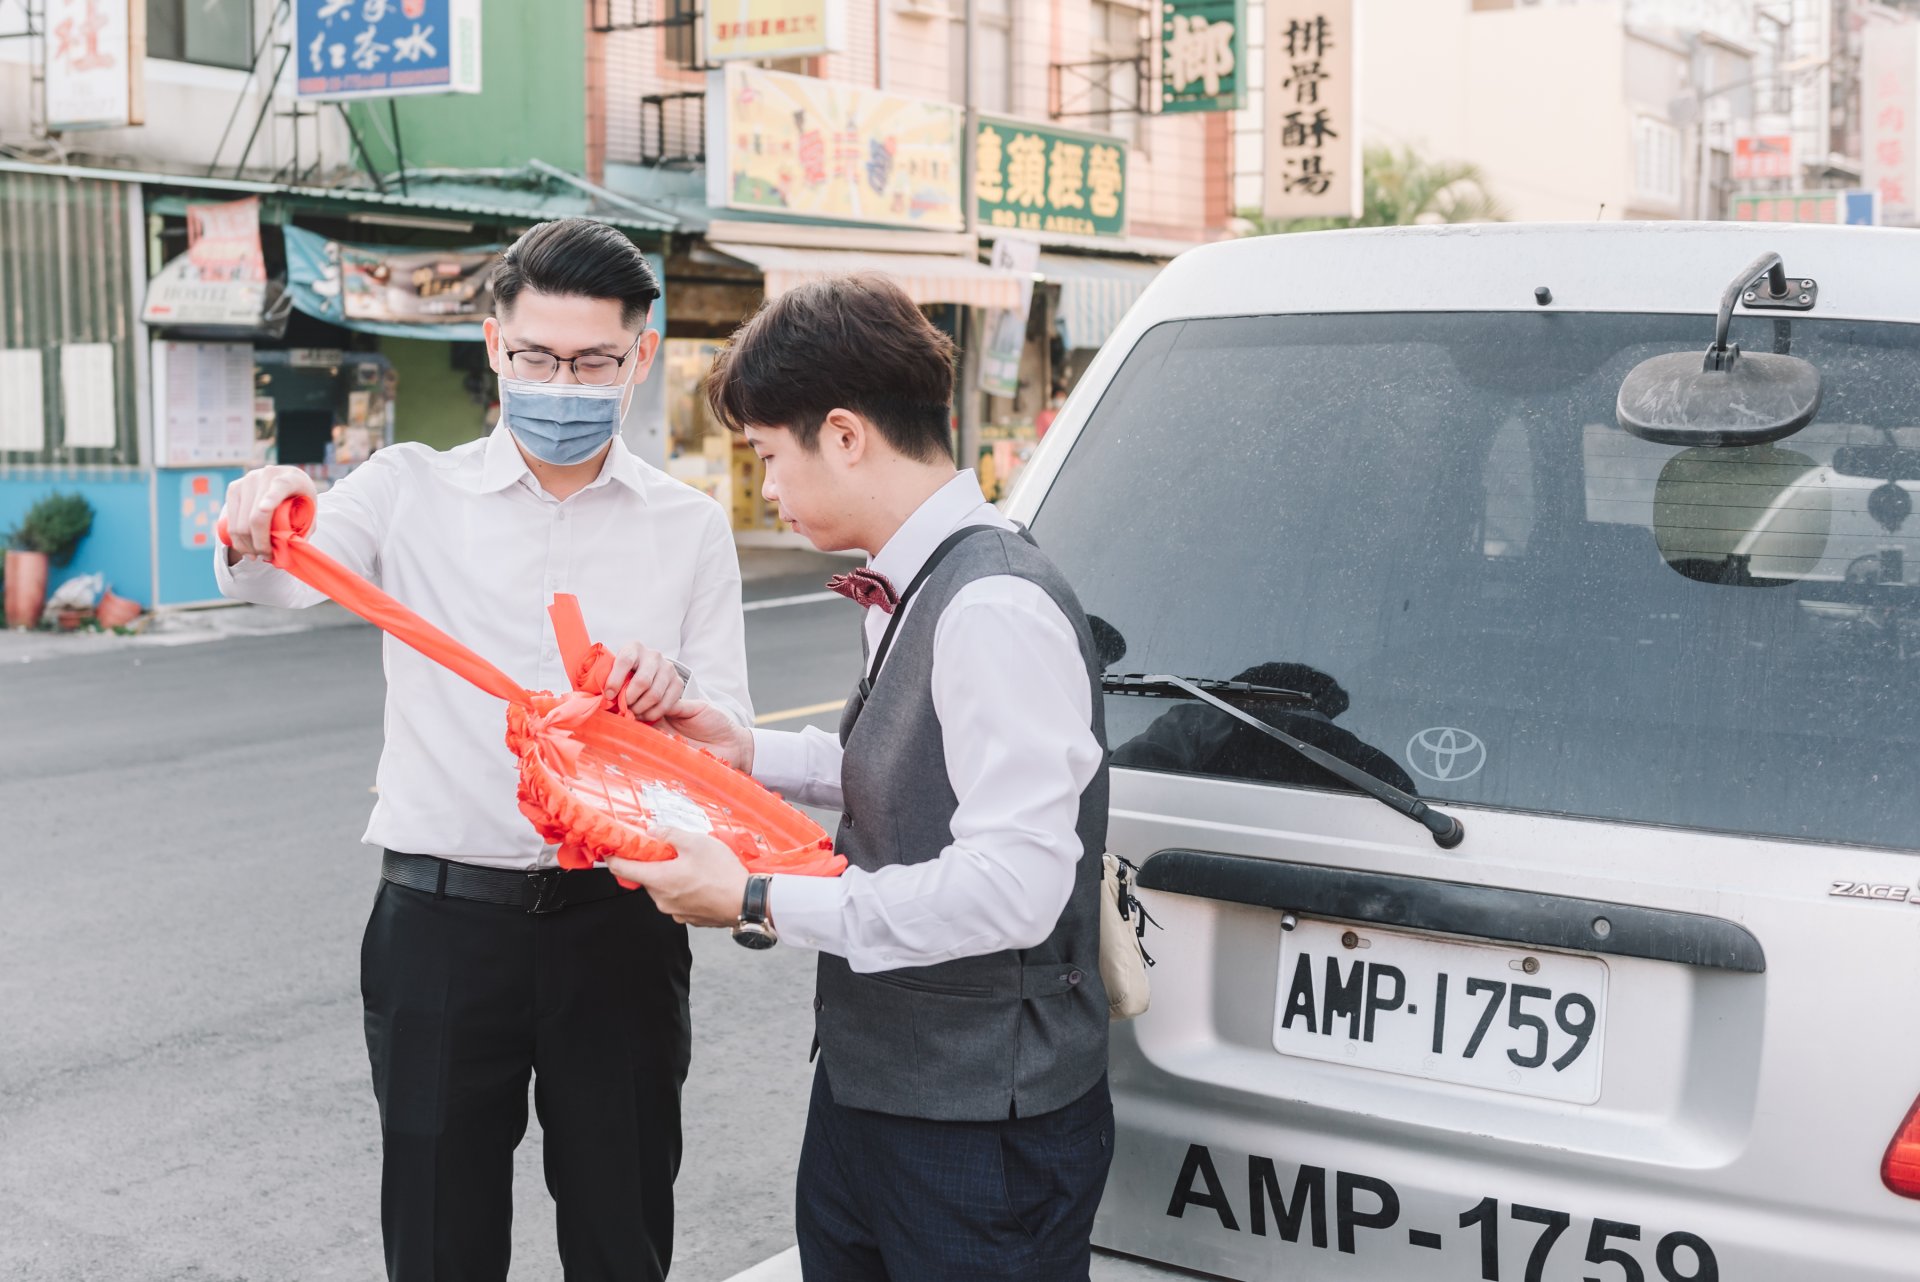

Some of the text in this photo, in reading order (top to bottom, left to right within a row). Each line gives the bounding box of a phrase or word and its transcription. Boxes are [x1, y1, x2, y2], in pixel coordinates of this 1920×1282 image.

[1282, 15, 1338, 195] 排骨酥湯
[1829, 881, 1910, 902] ZACE
[1166, 1142, 1720, 1282] AMP-1759
